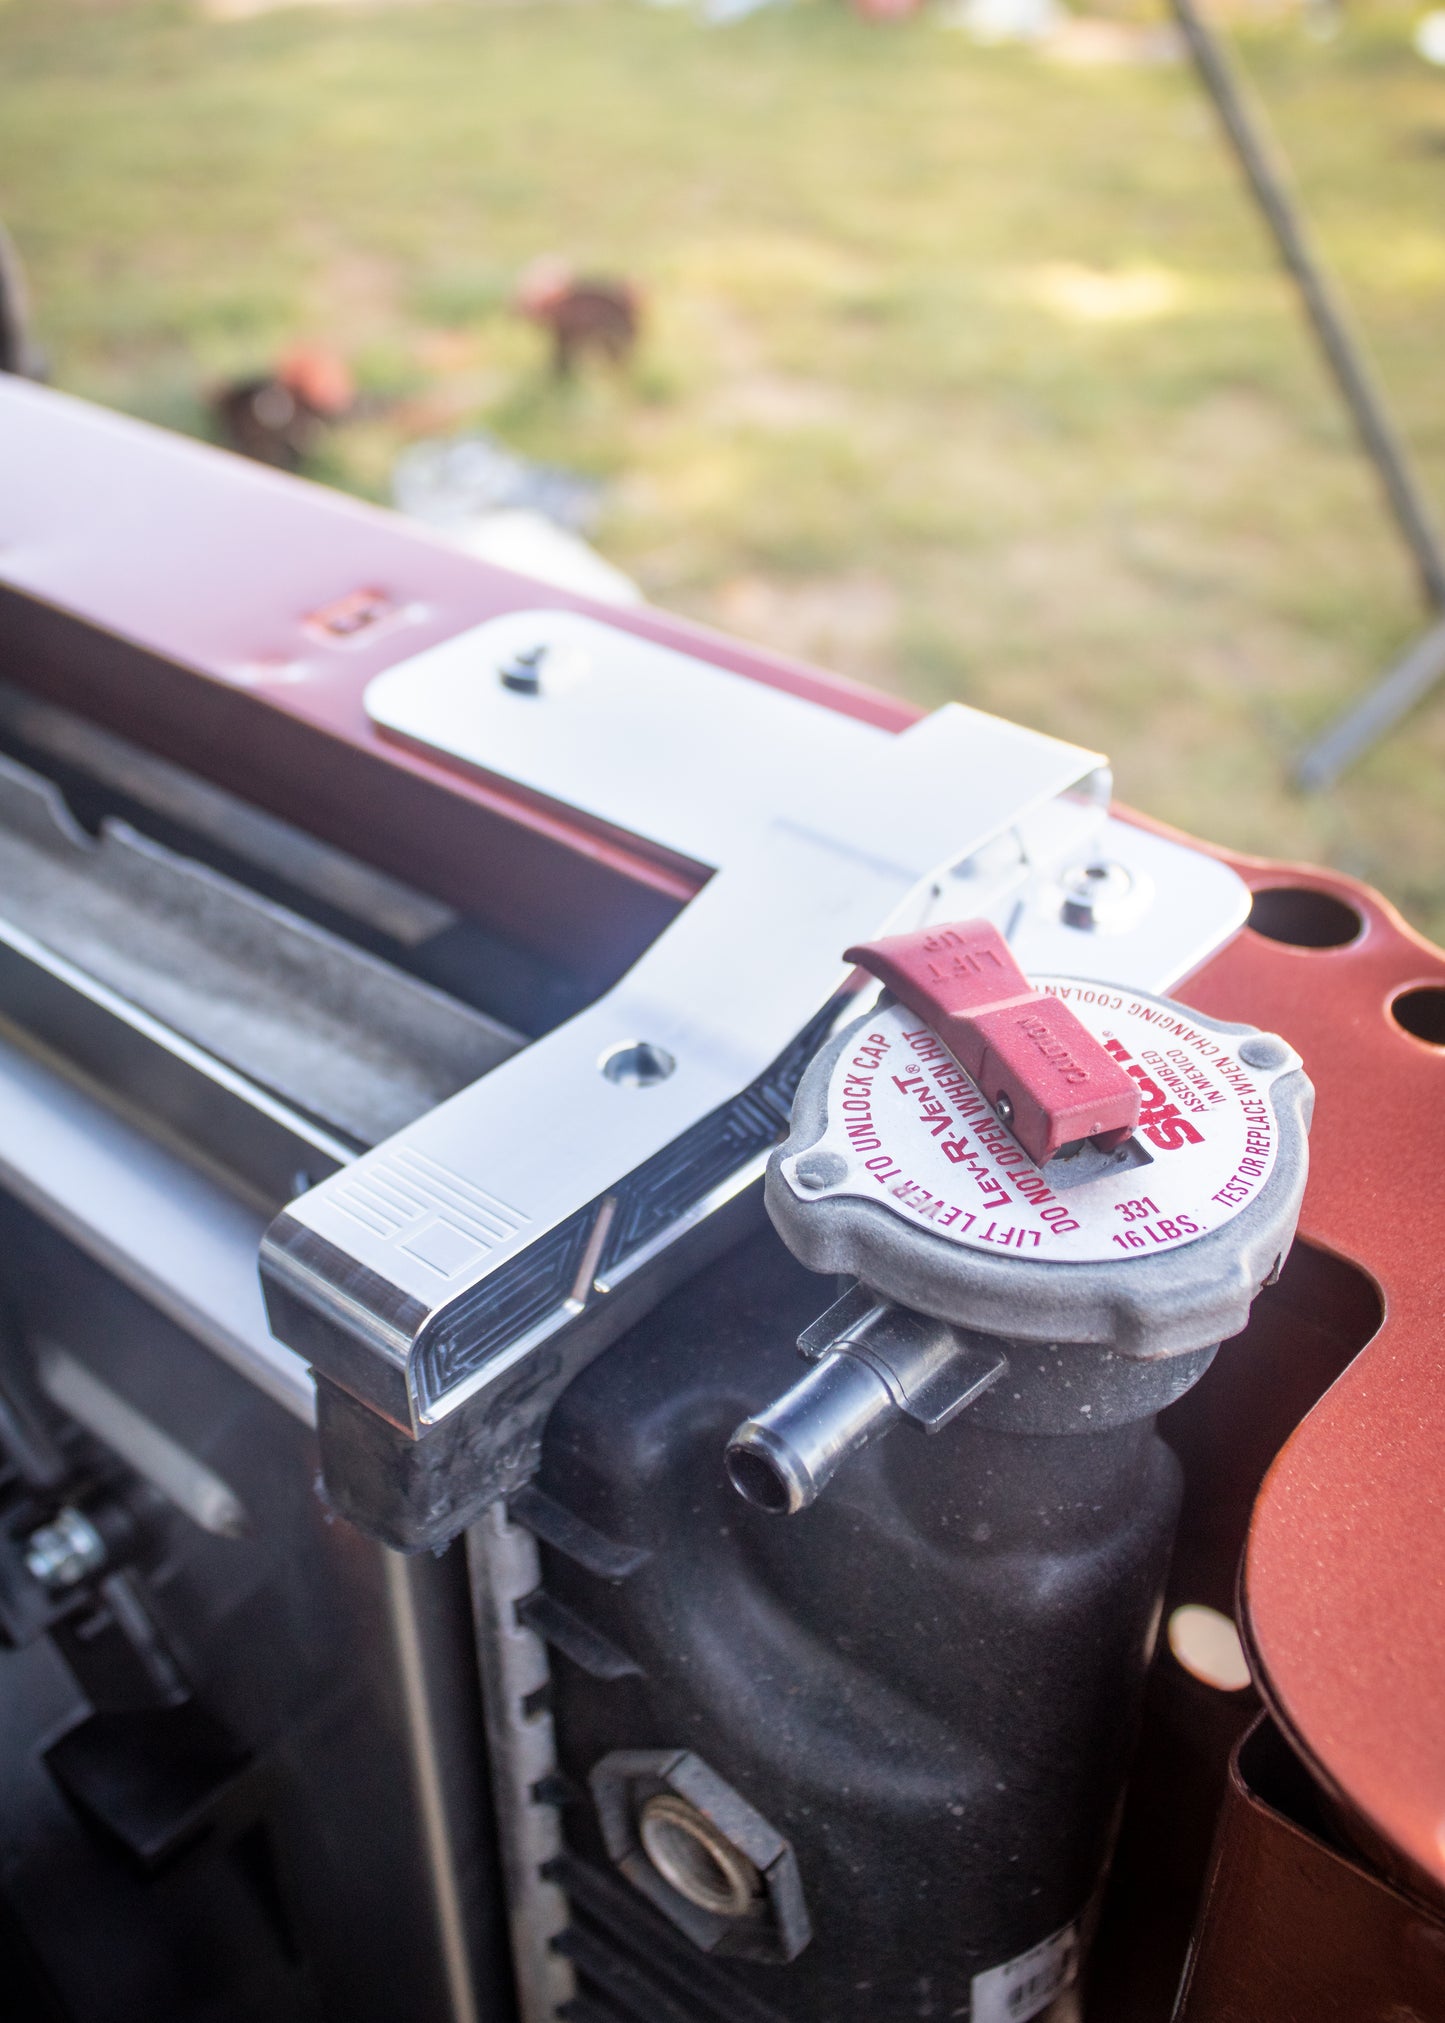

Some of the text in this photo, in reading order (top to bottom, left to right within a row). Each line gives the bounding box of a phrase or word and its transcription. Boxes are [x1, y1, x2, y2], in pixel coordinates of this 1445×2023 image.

[1127, 1002, 1221, 1056] CHANGING
[852, 1033, 891, 1070] CAP
[1016, 1015, 1090, 1084] CAUTION
[1141, 1050, 1210, 1113] ASSEMBLED
[1166, 1049, 1227, 1104] IN MEXICO
[1211, 1056, 1257, 1096] WHEN
[842, 1073, 882, 1152] UNLOCK
[902, 1029, 1080, 1235] DO NOT OPEN WHEN HOT
[1240, 1098, 1271, 1157] REPLACE
[864, 1155, 902, 1184] TO
[1238, 1157, 1267, 1177] OR
[1114, 1196, 1161, 1222] 331
[1211, 1175, 1254, 1208] TEST
[978, 1221, 1042, 1248] LIFT
[1112, 1214, 1207, 1250] 16 LBS.
